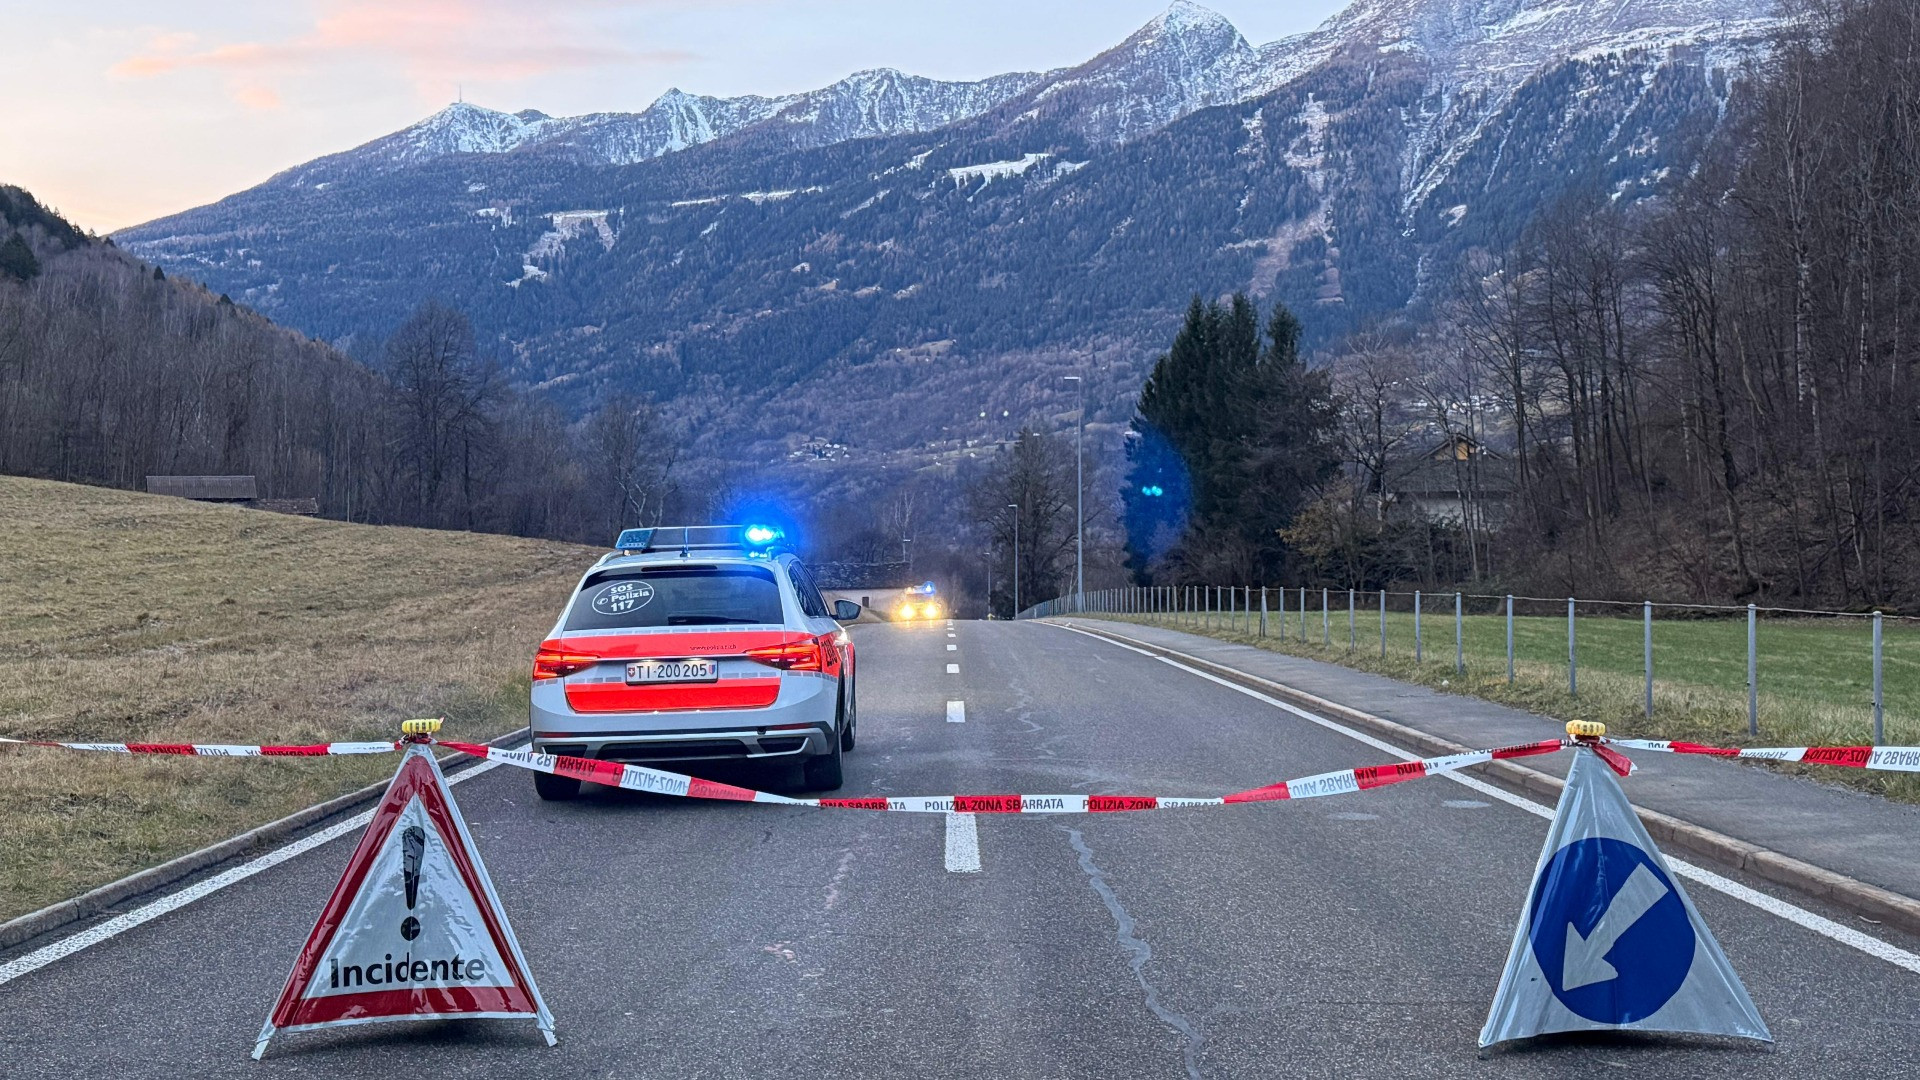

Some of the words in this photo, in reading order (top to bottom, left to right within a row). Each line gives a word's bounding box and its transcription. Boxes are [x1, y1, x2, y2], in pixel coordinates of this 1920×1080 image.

[611, 584, 633, 594] SOS
[611, 590, 650, 602] Polizia
[611, 600, 635, 612] 117
[1006, 798, 1064, 810] SBARRATA
[1083, 800, 1159, 810] POLIZIA-ZONA
[331, 952, 485, 988] Incidente
